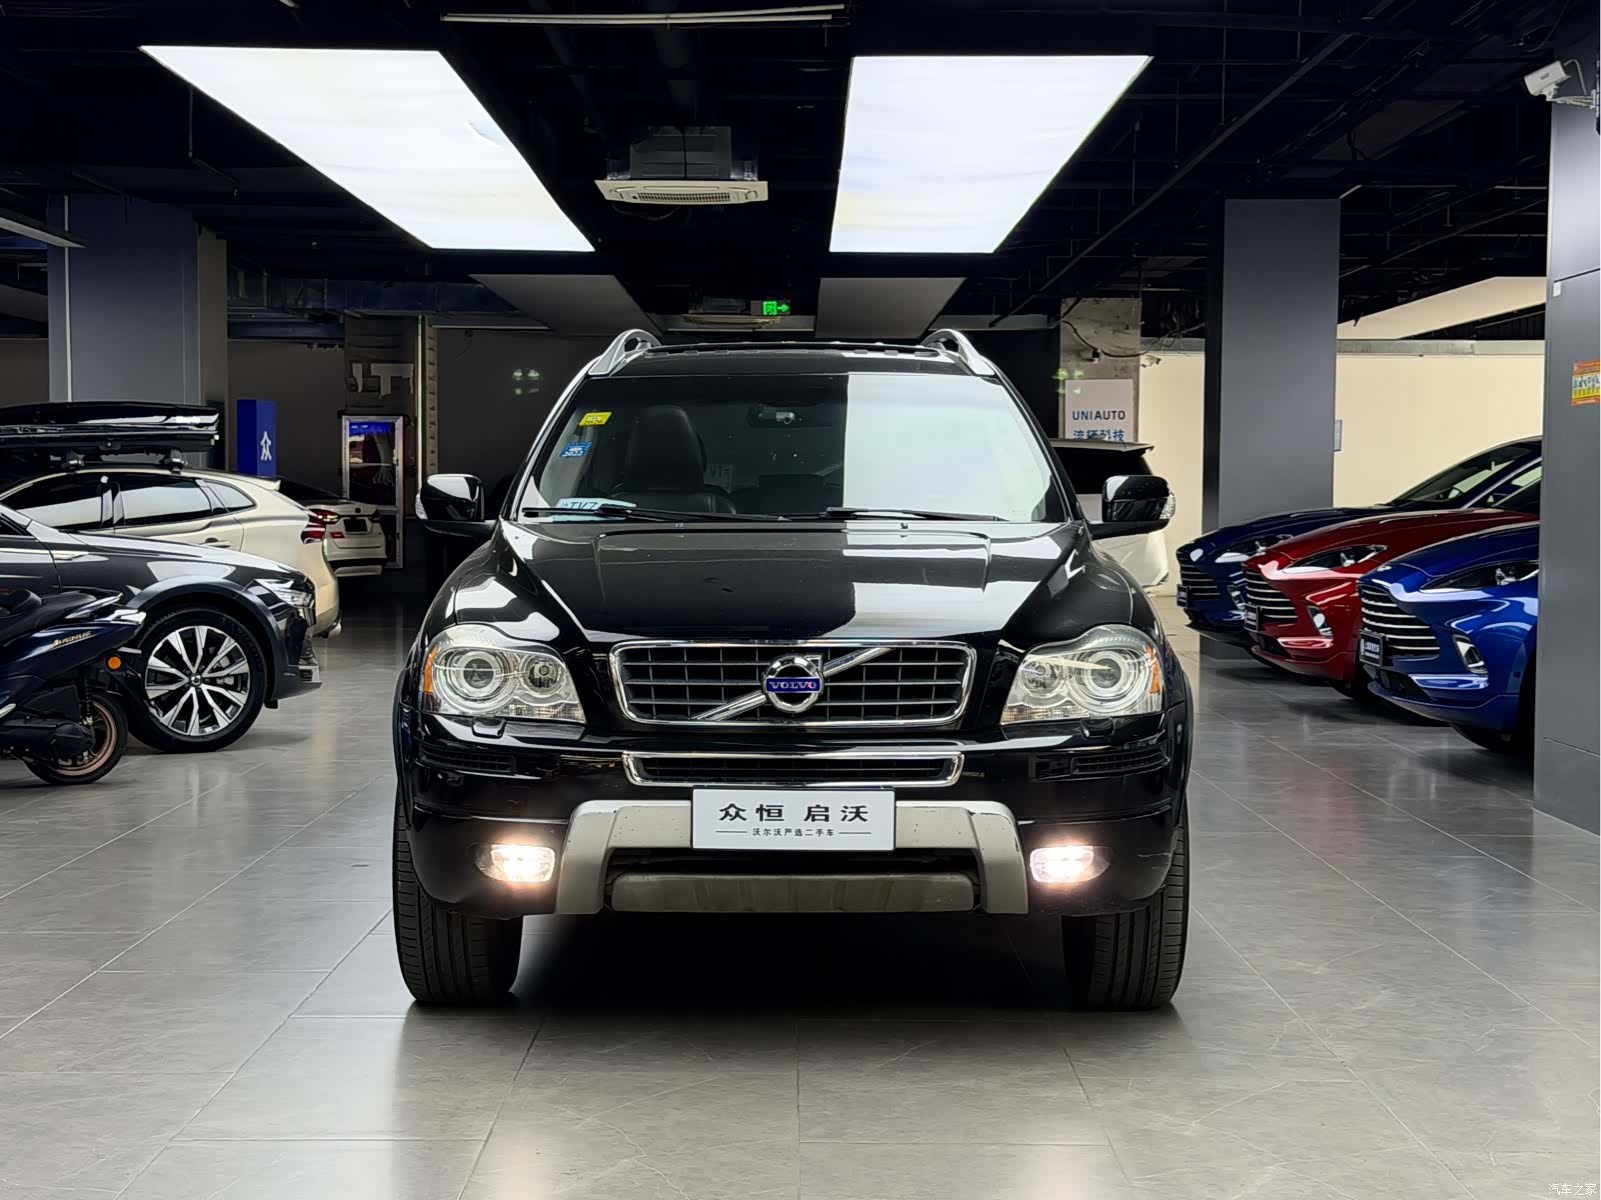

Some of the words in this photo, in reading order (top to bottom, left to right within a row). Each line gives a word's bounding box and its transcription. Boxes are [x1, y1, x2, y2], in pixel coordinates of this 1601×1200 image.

[1072, 411, 1126, 420] UNIAUTO
[768, 681, 817, 689] VOLVO
[718, 803, 785, 822] 众恒
[803, 804, 869, 823] 启沃
[752, 828, 834, 837] 沃尔沃严选二手车
